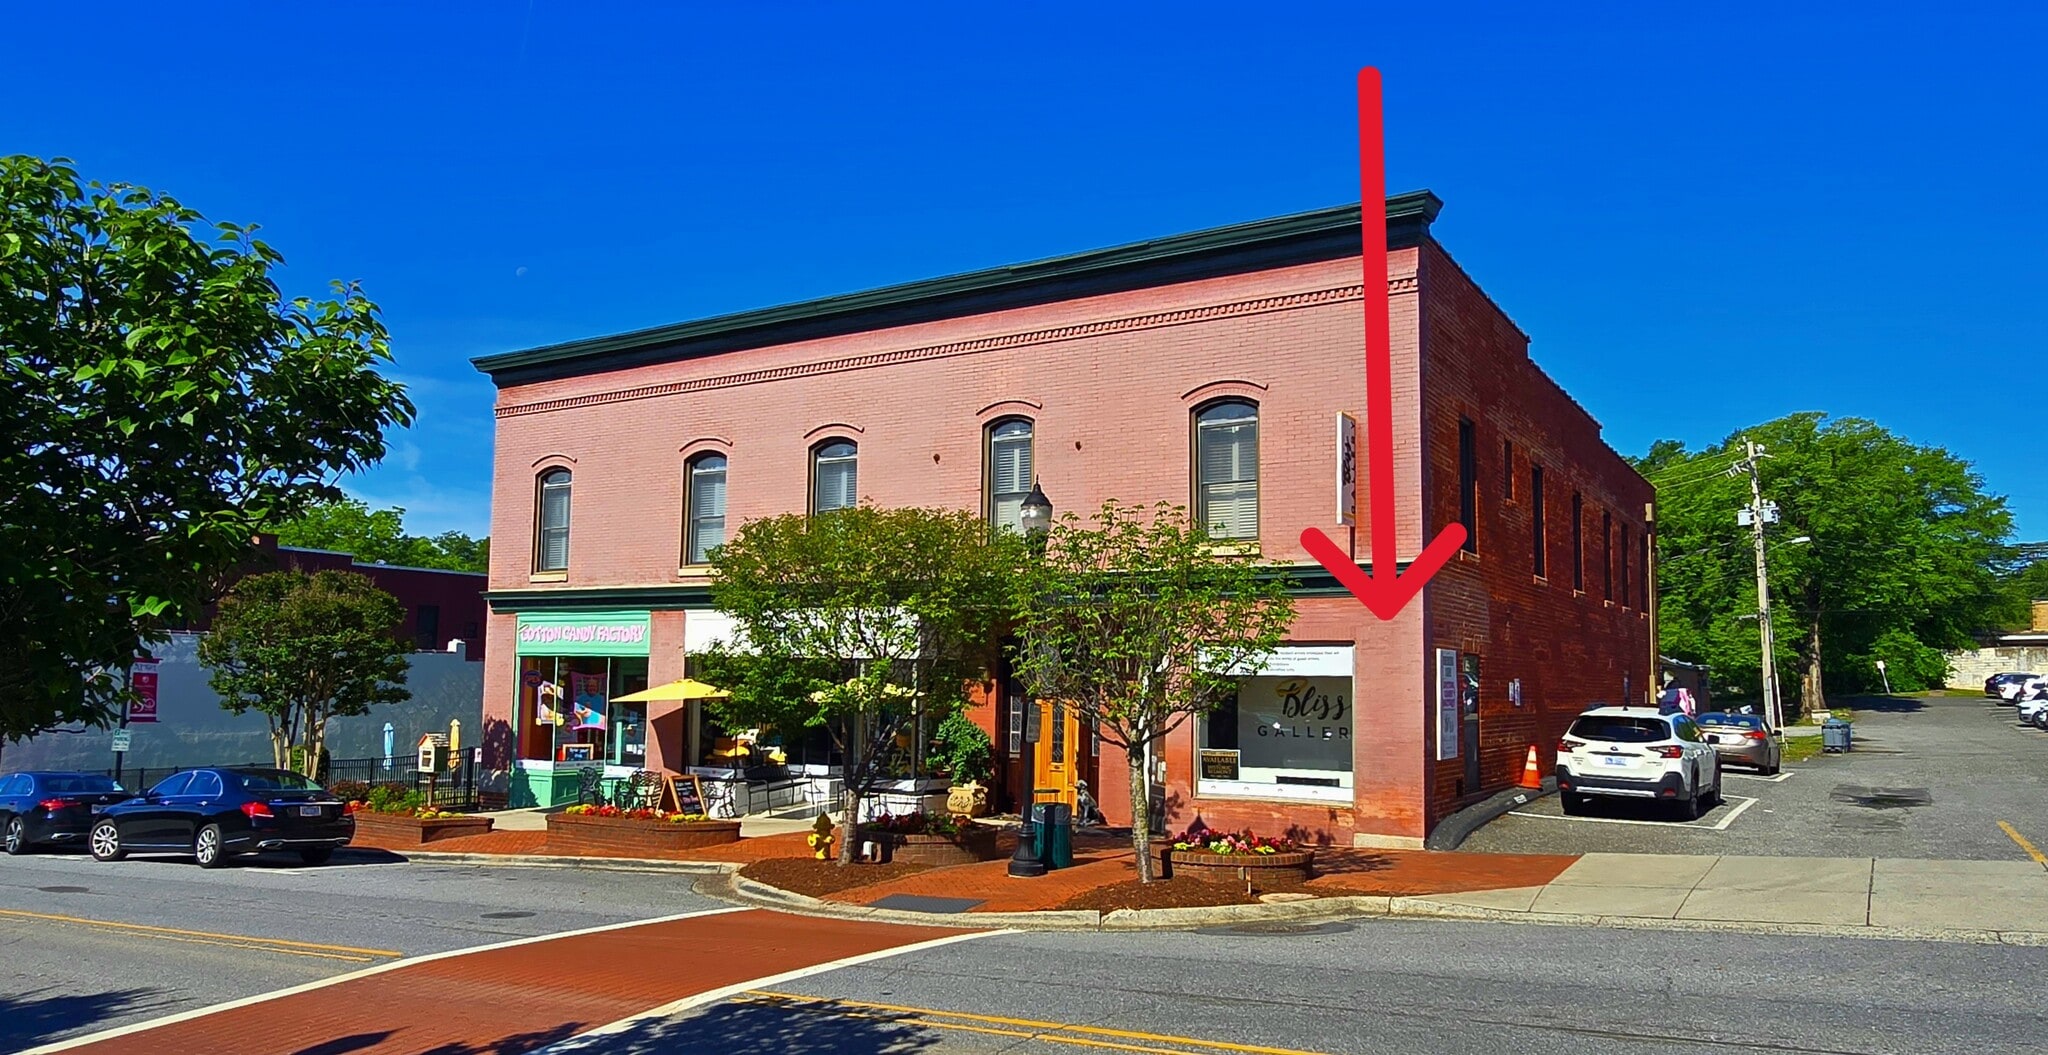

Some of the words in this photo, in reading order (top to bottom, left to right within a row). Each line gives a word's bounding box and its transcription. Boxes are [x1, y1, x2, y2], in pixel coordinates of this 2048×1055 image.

[521, 626, 561, 642] COTTON
[563, 625, 597, 643] CANDY
[599, 625, 646, 643] FACTORY
[1277, 683, 1352, 720] Bliss
[1202, 756, 1238, 764] AVAILABLE
